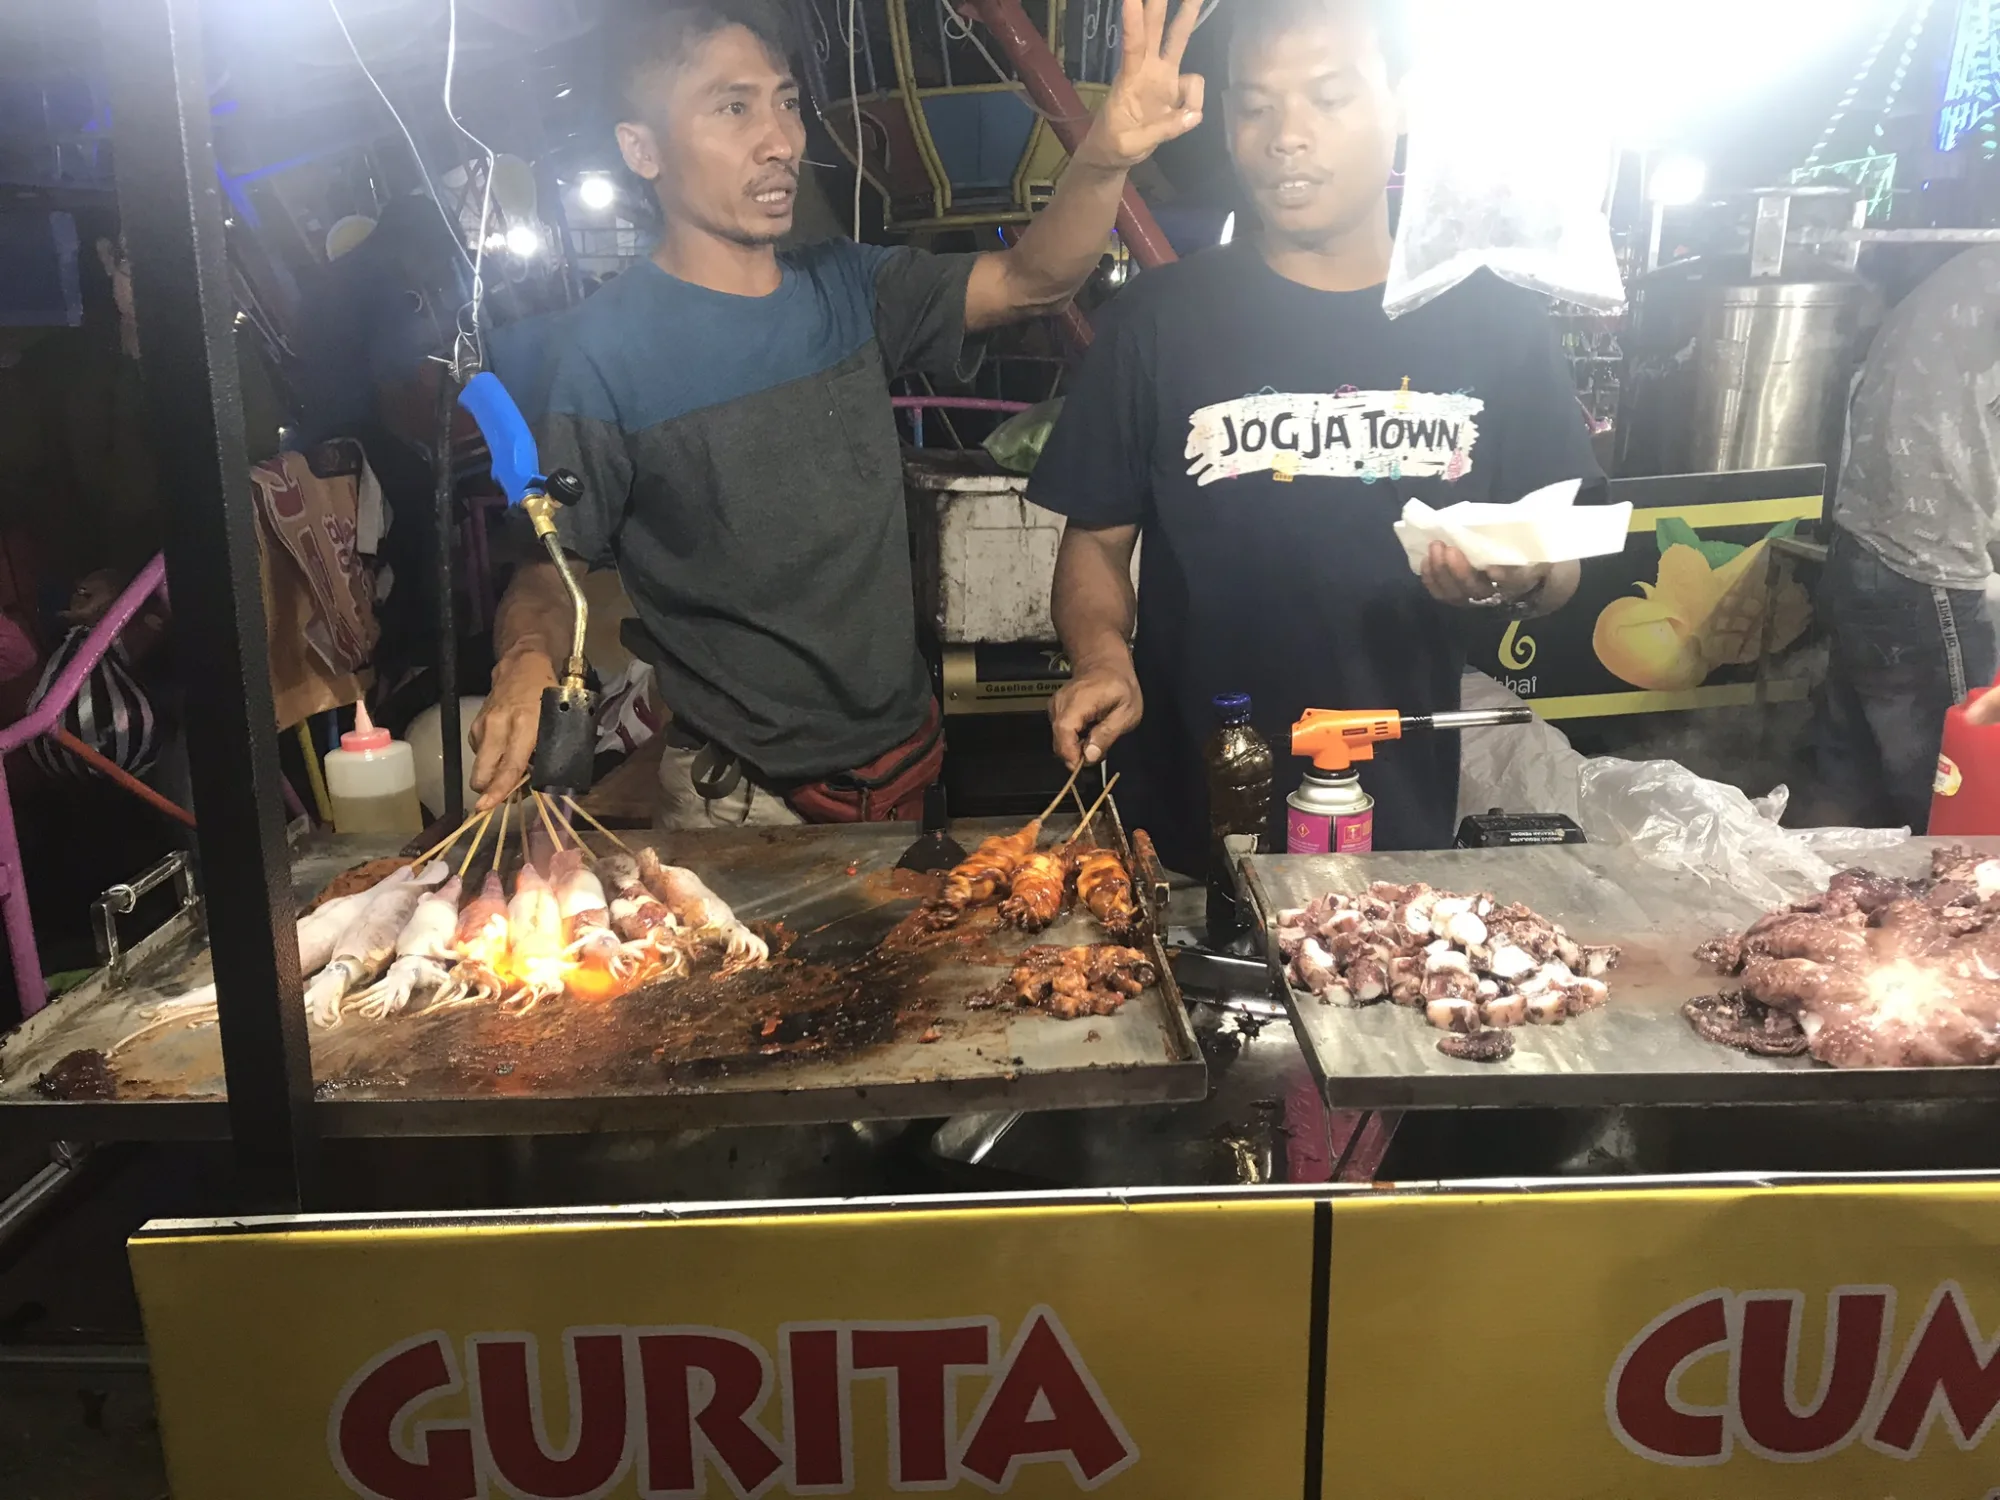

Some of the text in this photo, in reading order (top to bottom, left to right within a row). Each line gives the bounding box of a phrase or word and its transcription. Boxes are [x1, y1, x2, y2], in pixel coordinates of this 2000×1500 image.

[1361, 409, 1459, 451] TOWN
[985, 683, 1034, 693] Gasoline
[334, 1309, 1135, 1500] GURITA
